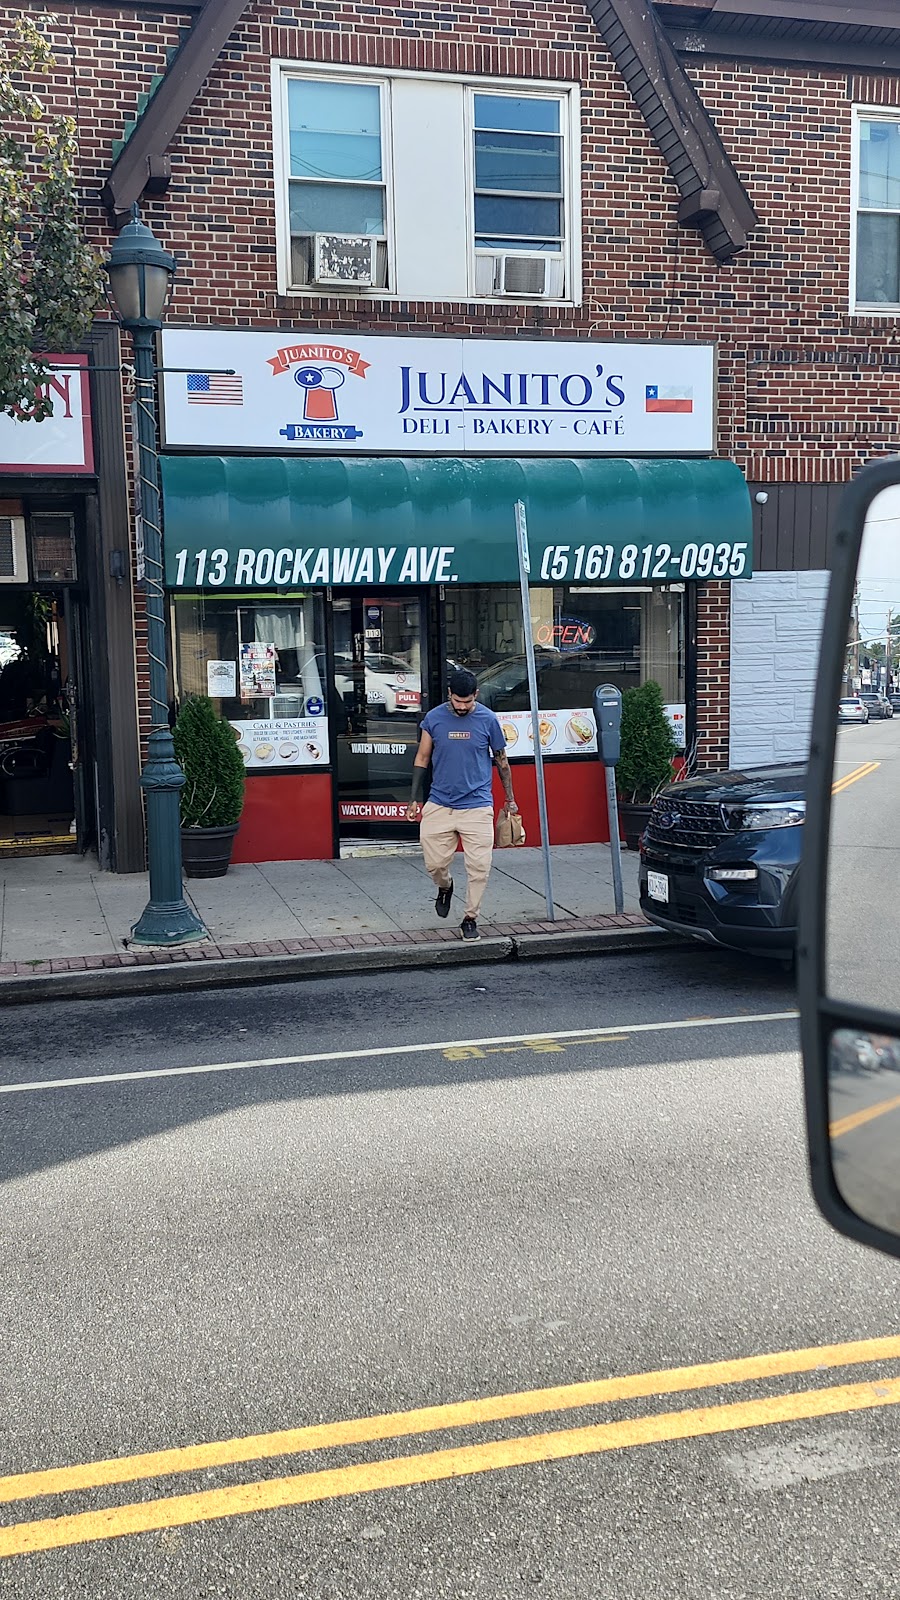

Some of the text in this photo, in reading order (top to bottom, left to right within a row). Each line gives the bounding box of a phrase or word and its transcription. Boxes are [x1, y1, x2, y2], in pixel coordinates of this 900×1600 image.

[282, 345, 355, 363] JUANITO'S
[397, 364, 626, 414] JUANITO'S
[293, 426, 349, 440] BAKERY
[402, 417, 451, 434] DELI
[472, 418, 554, 435] BAKERY
[573, 415, 625, 435] CAFÉ
[174, 546, 459, 586] 113 ROCKAWAY AVE.
[540, 542, 748, 580] (516) 812-0935
[366, 629, 380, 638] 113
[536, 625, 592, 645] OPEN
[283, 720, 317, 728] PASTRIES
[351, 743, 407, 755] WATCH YOUR STEP
[341, 805, 372, 816] WATCH
[373, 805, 398, 816] YOUR
